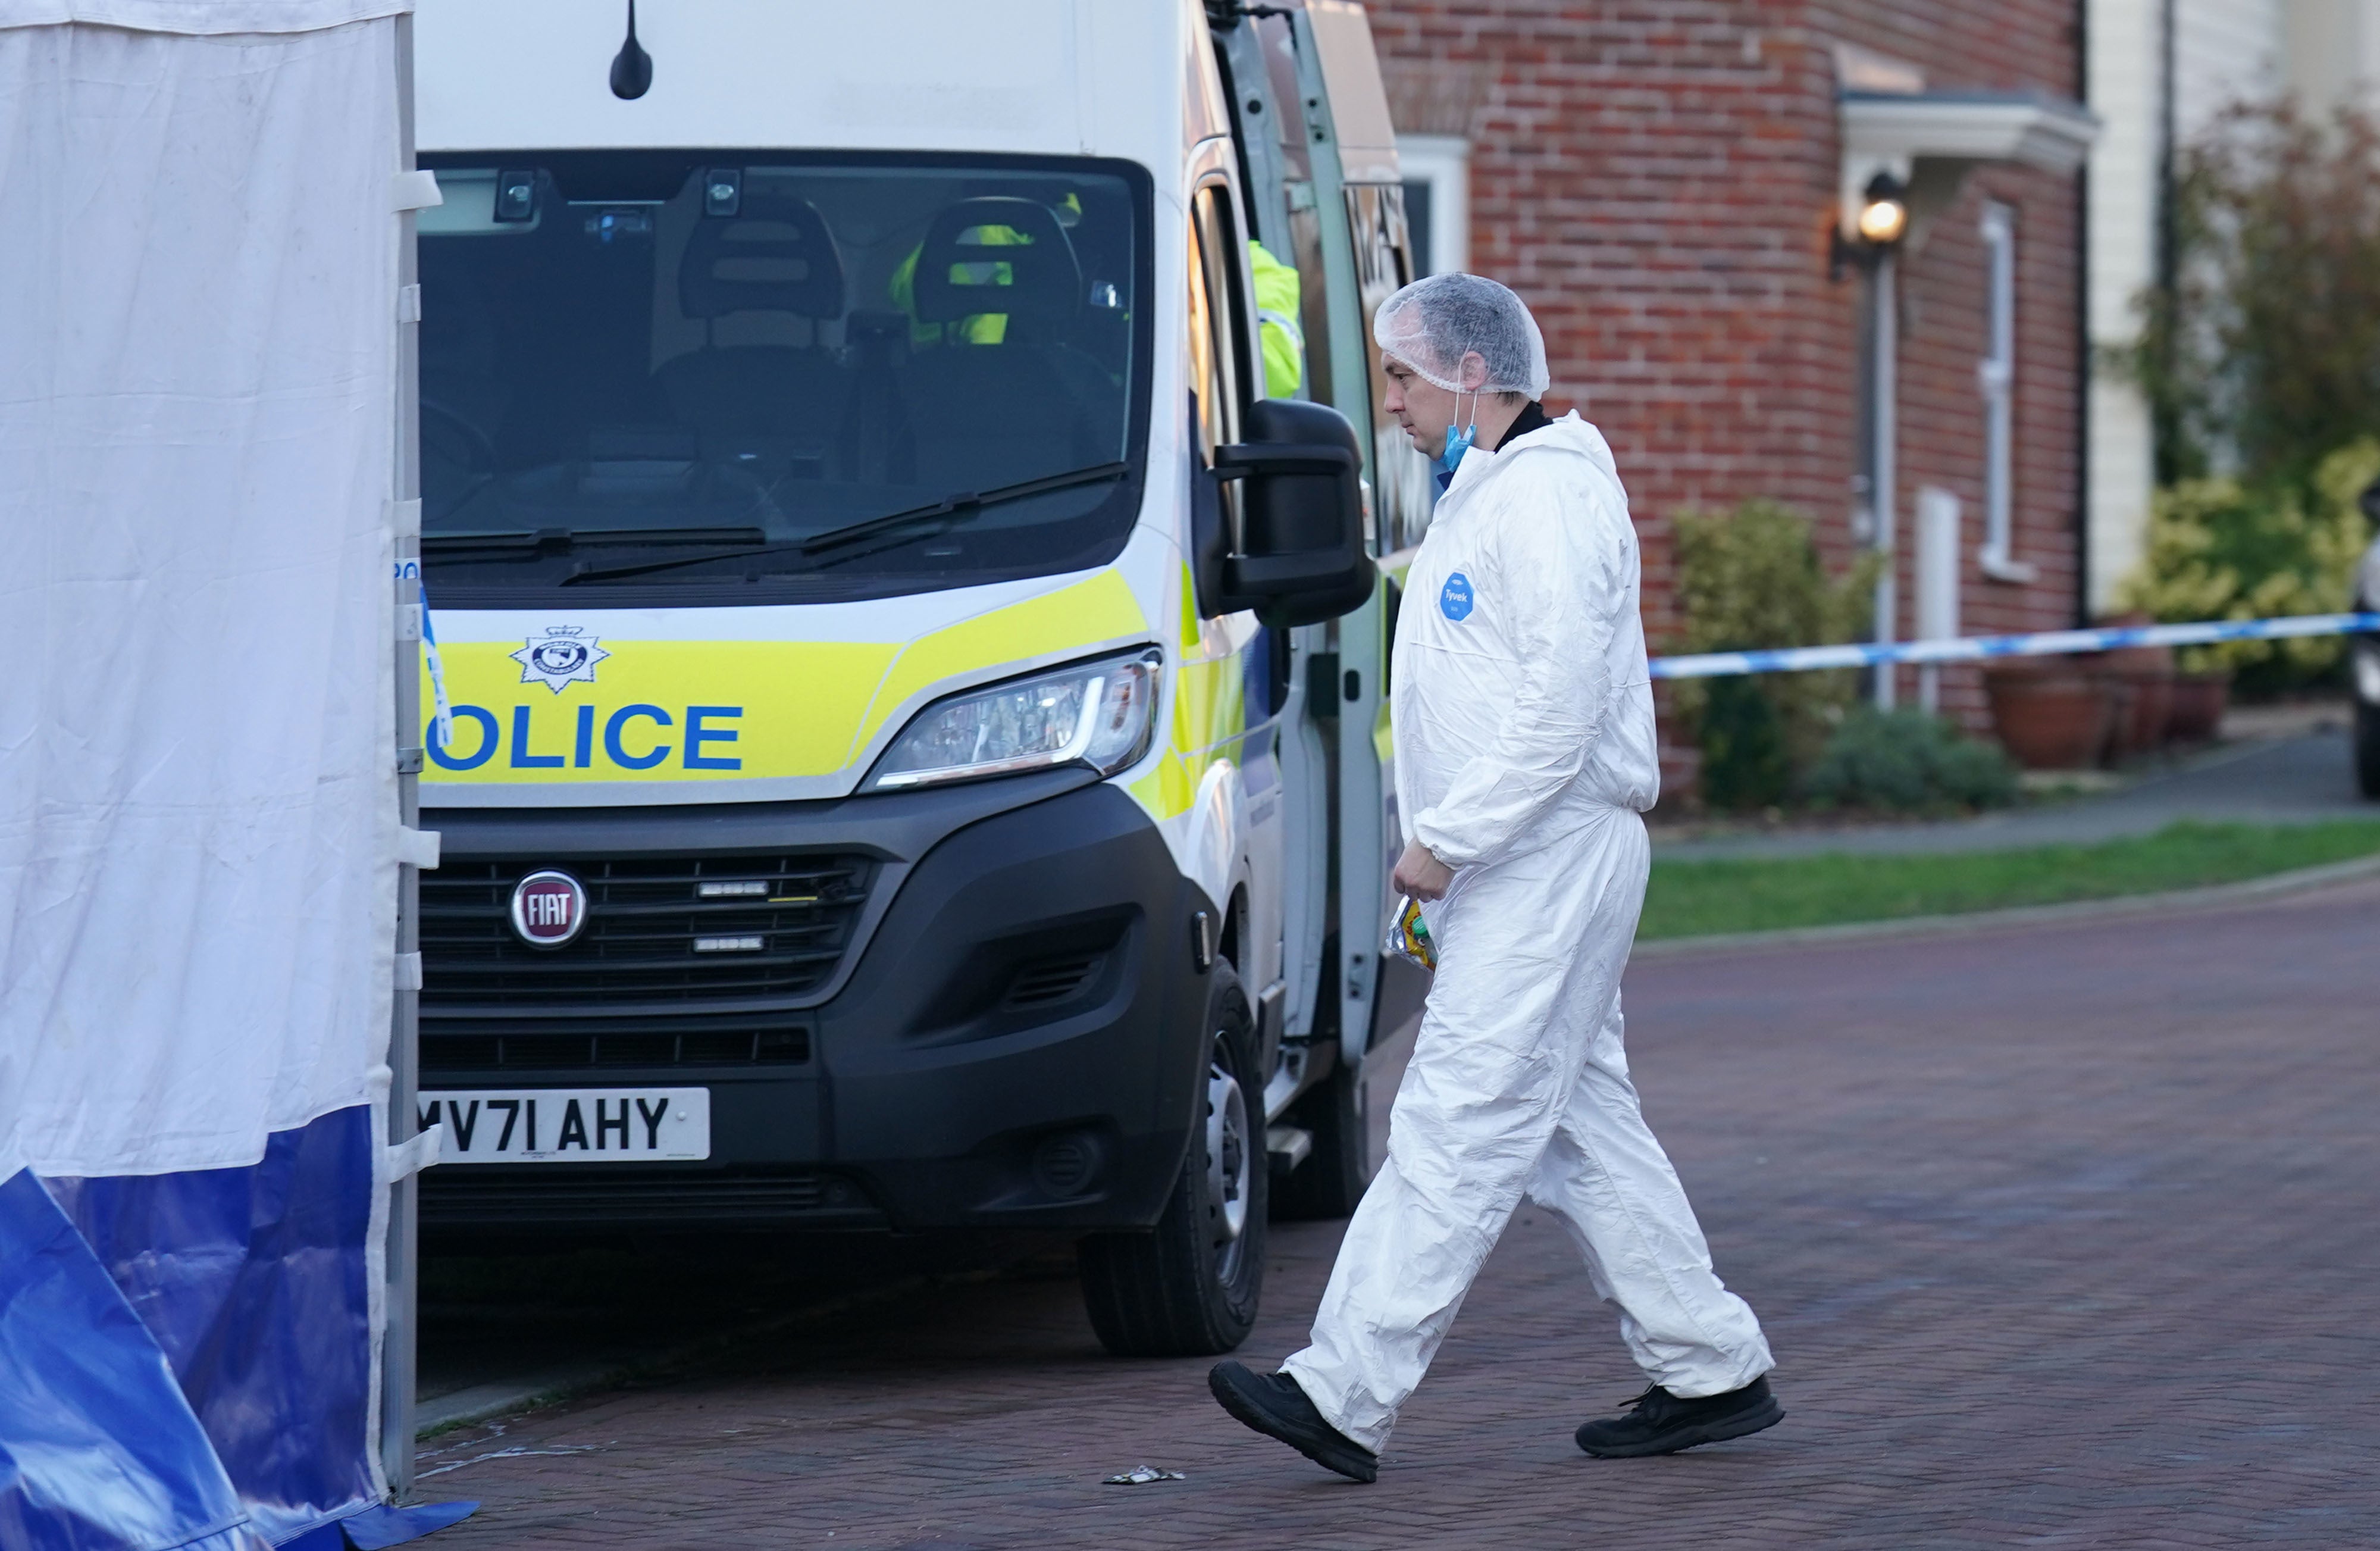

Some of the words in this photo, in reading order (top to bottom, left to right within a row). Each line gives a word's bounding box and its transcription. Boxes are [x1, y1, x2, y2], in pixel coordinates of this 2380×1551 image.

[1446, 588, 1468, 603] Tyvek
[426, 704, 743, 771] OLICE
[528, 893, 571, 926] FIAT
[558, 1098, 668, 1150] AHY
